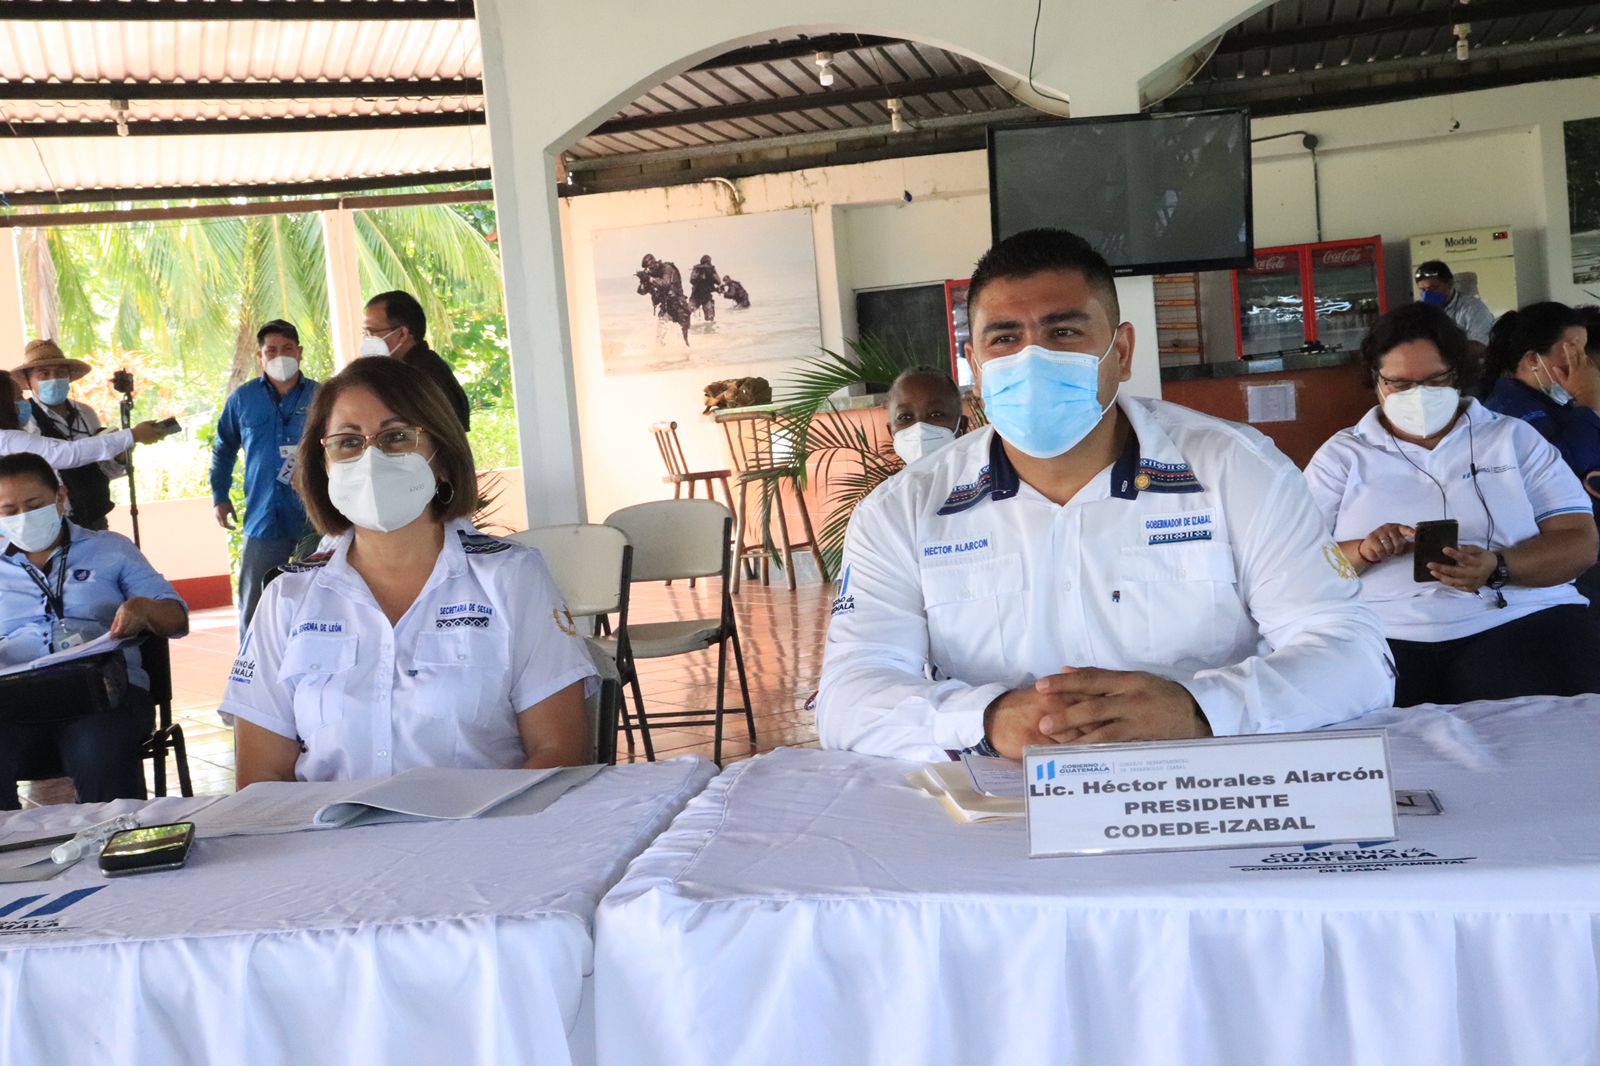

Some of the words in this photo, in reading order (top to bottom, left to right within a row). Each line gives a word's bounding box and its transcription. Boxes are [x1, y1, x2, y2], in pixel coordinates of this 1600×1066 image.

[1444, 236, 1478, 248] Modelo
[1145, 518, 1182, 529] GOBERNADOR
[1183, 517, 1191, 526] DE
[1191, 514, 1212, 525] IZABAL
[924, 545, 953, 557] HECTOR
[954, 538, 989, 553] ALARCON
[469, 603, 476, 612] DE
[320, 623, 327, 632] DE
[1029, 783, 1075, 797] Lic.
[1083, 779, 1168, 795] Héctor
[1175, 773, 1276, 789] Morales
[1284, 767, 1384, 784] Alarcón
[1124, 794, 1290, 815] PRESIDENTE
[1103, 816, 1316, 839] CODEDE-IZABAL
[1261, 852, 1438, 863] GUATEMALA
[1269, 848, 1397, 858] GOBIERNO
[1346, 860, 1468, 868] DEPARTAMENTAL
